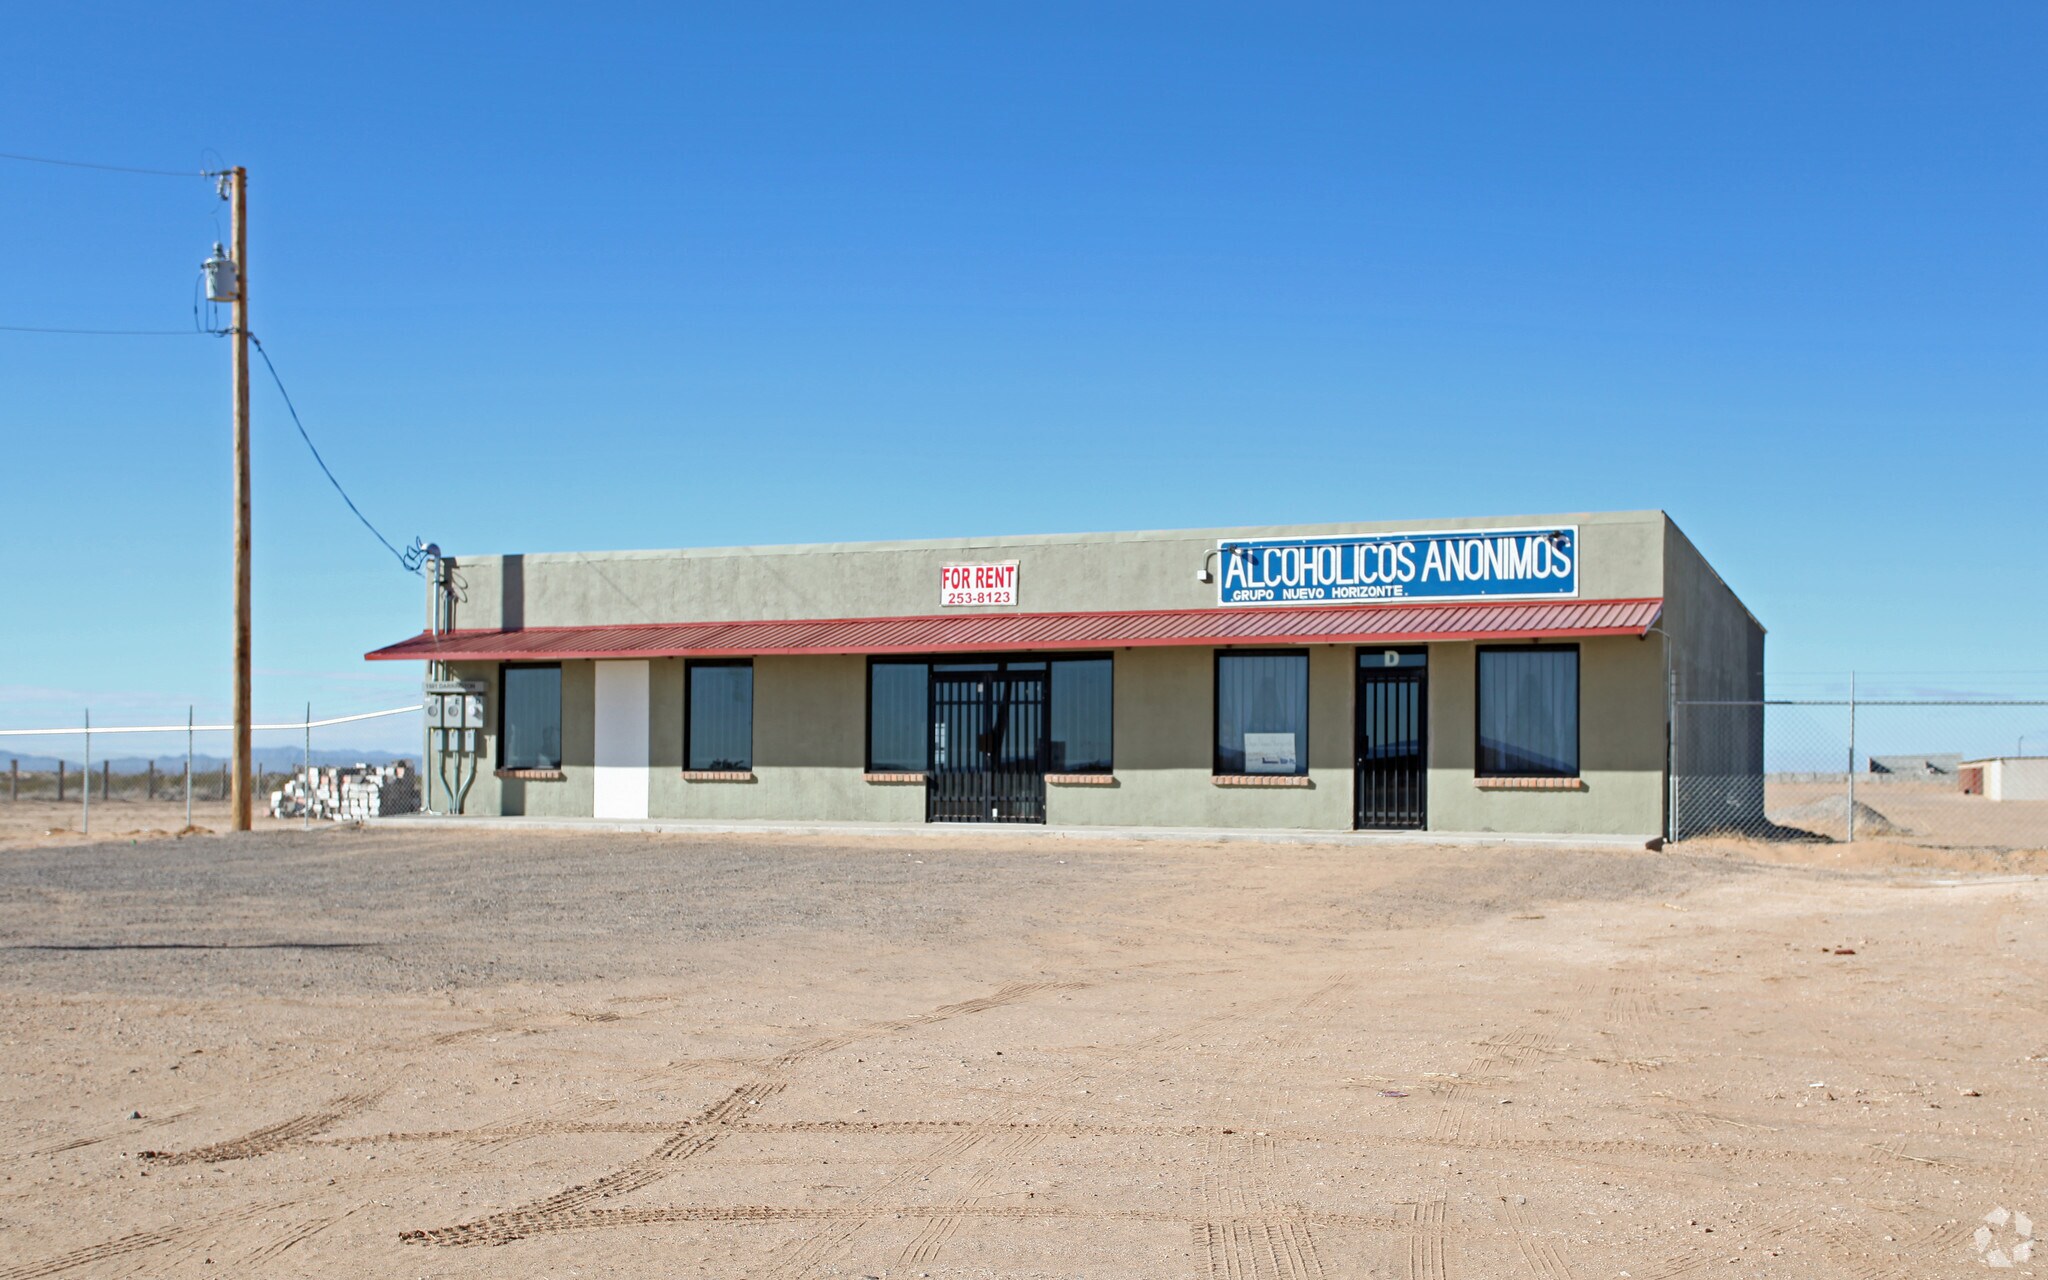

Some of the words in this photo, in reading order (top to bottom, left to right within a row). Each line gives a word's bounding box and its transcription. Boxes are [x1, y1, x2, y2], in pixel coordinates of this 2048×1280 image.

[1225, 541, 1415, 588] ALCOHOLICOS
[1421, 536, 1572, 583] ANONIMOS
[942, 567, 970, 589] FOR
[976, 566, 1014, 588] RENT
[948, 592, 1010, 604] 253-8123
[1233, 589, 1275, 601] GRUPO
[1283, 587, 1325, 599] NUEVO
[1384, 650, 1400, 667] D
